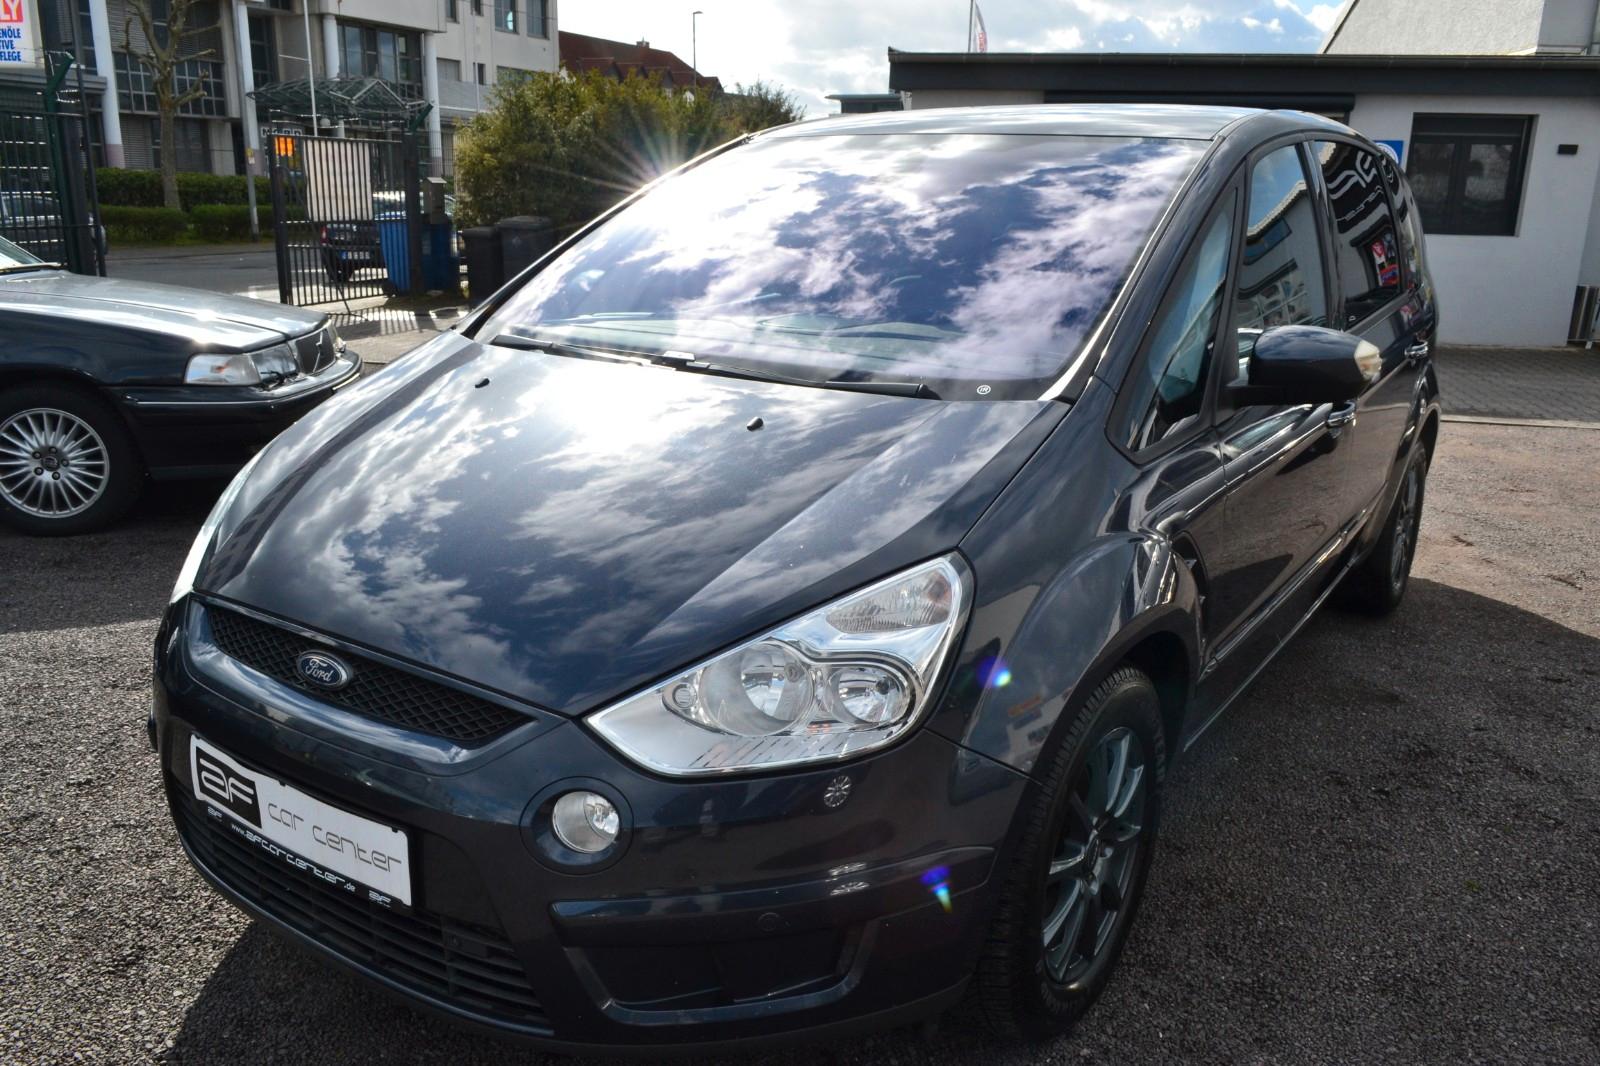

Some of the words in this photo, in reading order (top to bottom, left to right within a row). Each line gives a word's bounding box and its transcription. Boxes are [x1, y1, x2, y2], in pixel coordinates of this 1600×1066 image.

[305, 658, 334, 682] Ford
[267, 802, 304, 831] car
[312, 825, 402, 873] center
